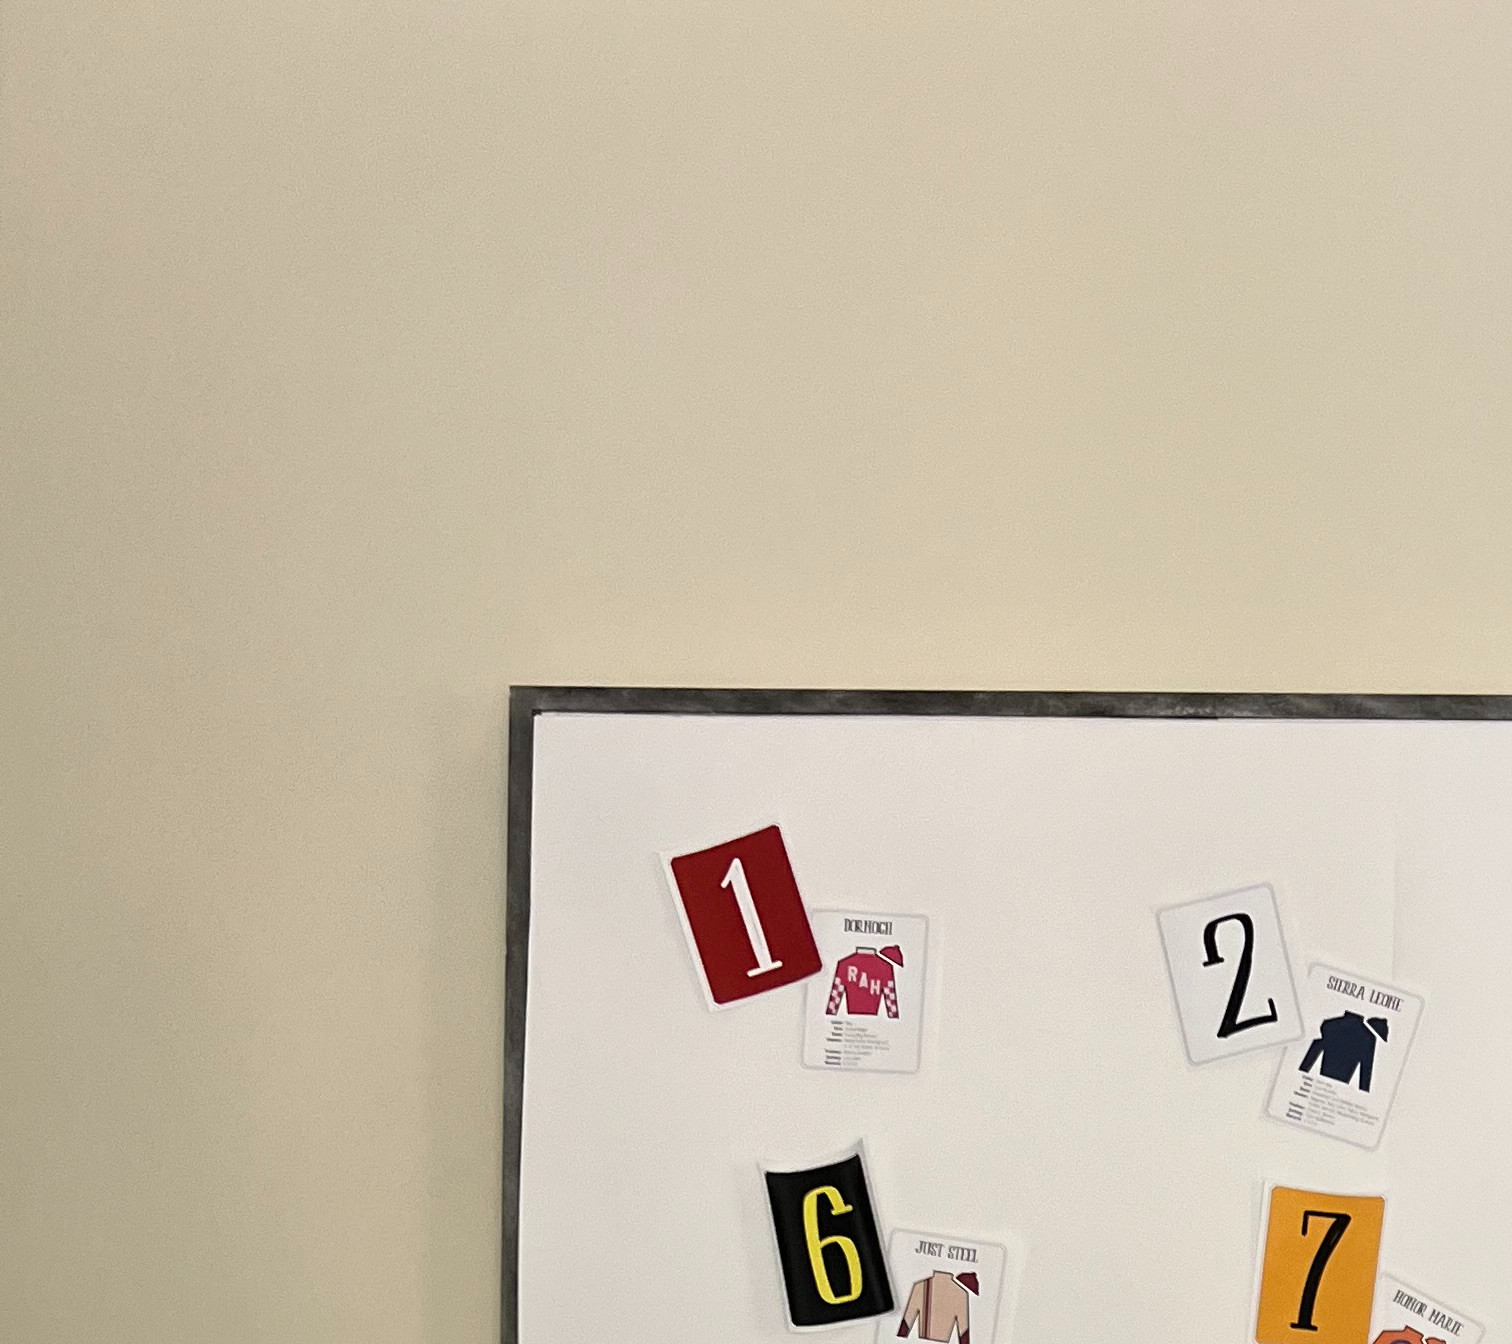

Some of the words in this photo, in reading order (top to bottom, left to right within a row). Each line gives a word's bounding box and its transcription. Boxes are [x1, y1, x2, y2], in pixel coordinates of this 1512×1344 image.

[720, 858, 783, 978] 1
[847, 965, 881, 995] RAH
[1203, 913, 1278, 1038] 2
[1327, 975, 1365, 1001] SIERRA
[1369, 989, 1404, 1012] LEONE
[803, 1185, 862, 1305] 6
[915, 1241, 945, 1258] JUST
[948, 1245, 978, 1263] STEEL
[1290, 1210, 1351, 1331] 7
[1393, 1289, 1427, 1318] HONOR
[1429, 1309, 1465, 1337] MARIE
